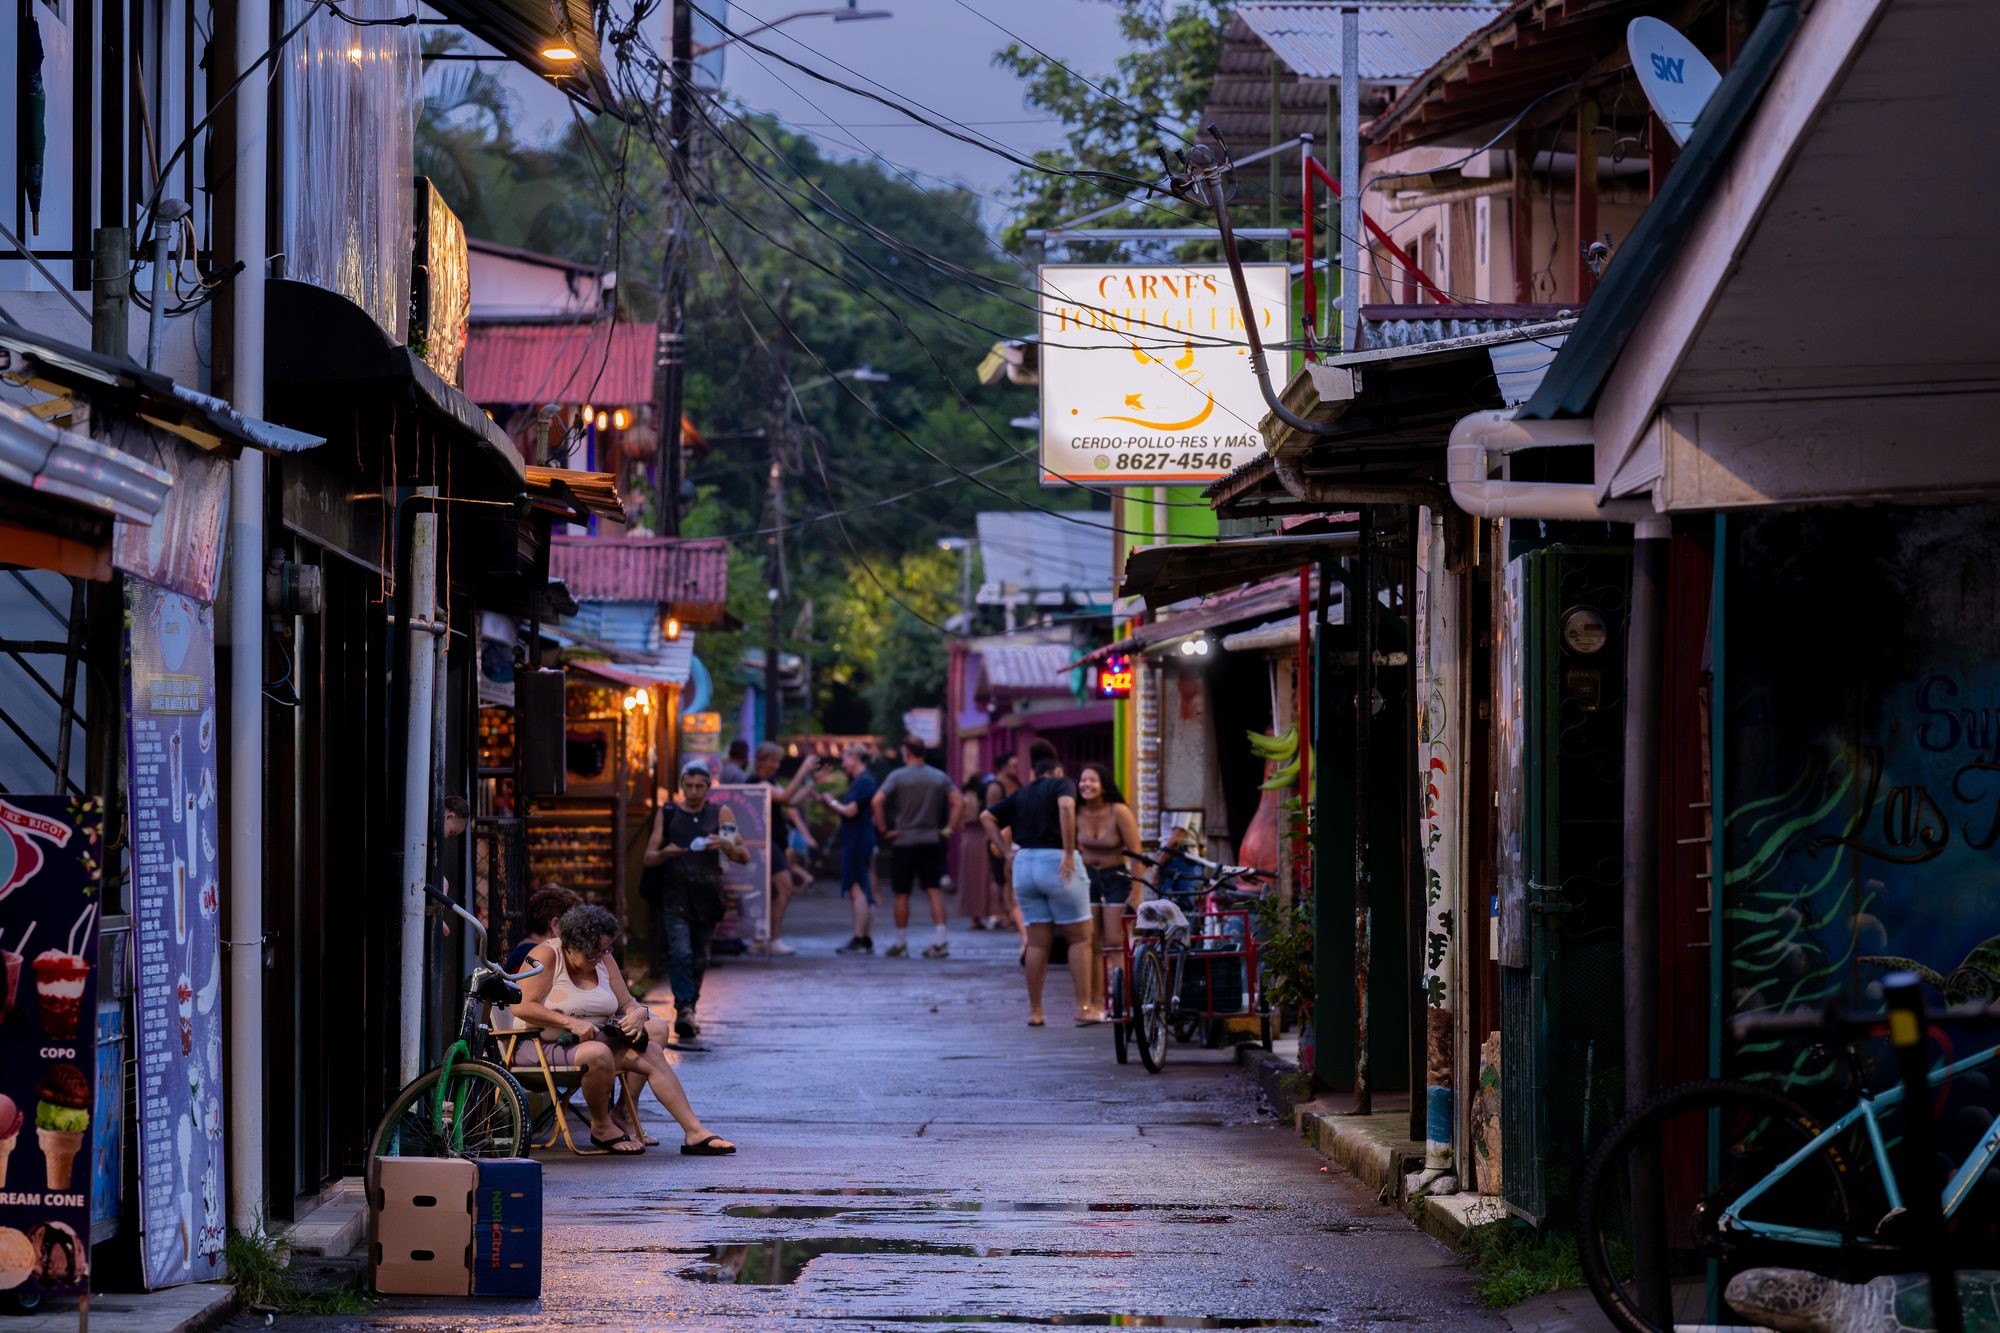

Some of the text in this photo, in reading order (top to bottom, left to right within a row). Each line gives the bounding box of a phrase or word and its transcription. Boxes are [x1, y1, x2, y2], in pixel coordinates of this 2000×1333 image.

[1650, 52, 1685, 84] SKY
[1098, 274, 1217, 299] CARNES
[1071, 432, 1257, 450] CERDO-POLLO-RES Y MÁS
[1116, 452, 1232, 469] 8627-4546
[1917, 674, 2000, 763] Su
[1806, 746, 1950, 865] Las
[40, 1047, 76, 1059] COPO
[1797, 1115, 1849, 1173] MAXIS
[44, 1193, 85, 1207] CONE
